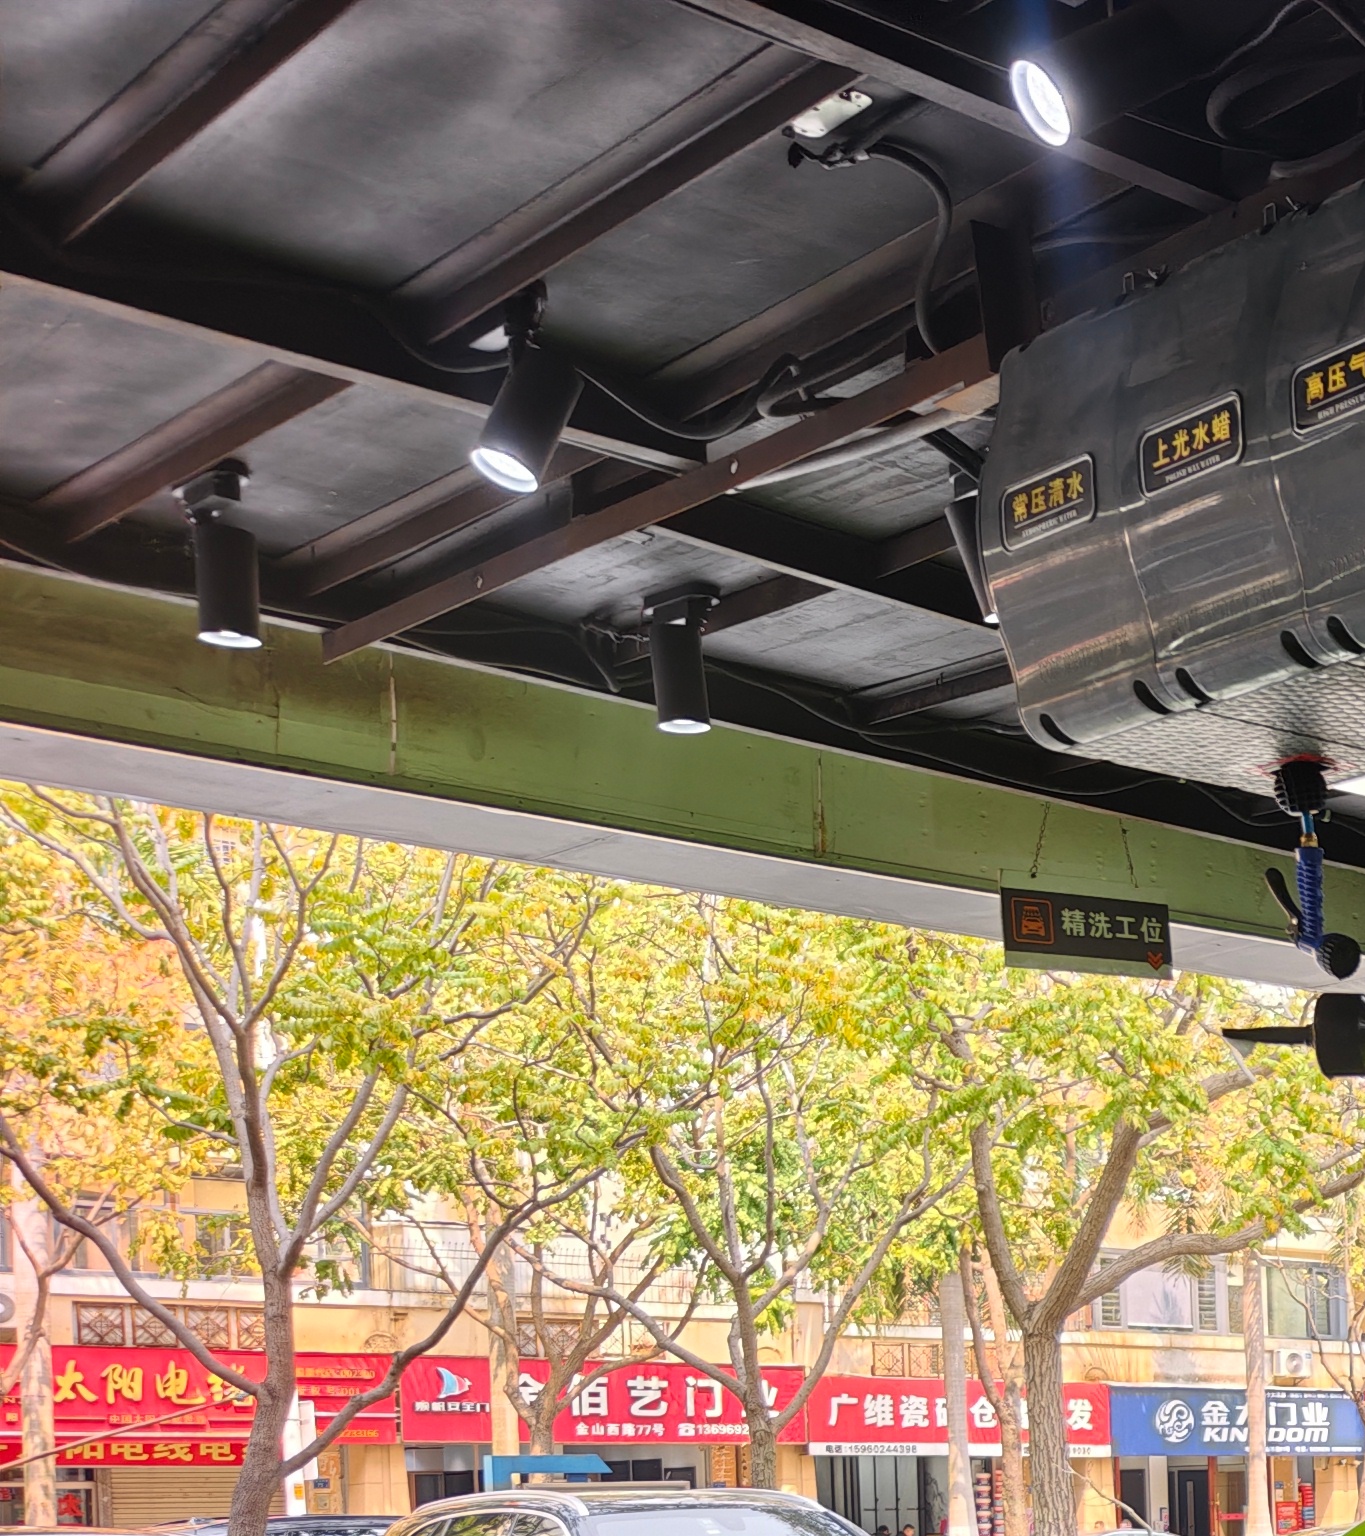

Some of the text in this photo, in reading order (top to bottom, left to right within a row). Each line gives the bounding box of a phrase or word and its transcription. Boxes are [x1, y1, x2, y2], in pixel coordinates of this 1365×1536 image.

[1152, 410, 1231, 468] 上光水蜡
[1012, 470, 1084, 522] 常压清水
[1060, 907, 1165, 944] 精洗工位
[829, 1394, 1094, 1431] 广维瓷仓发
[1203, 1427, 1329, 1443] KINDOM
